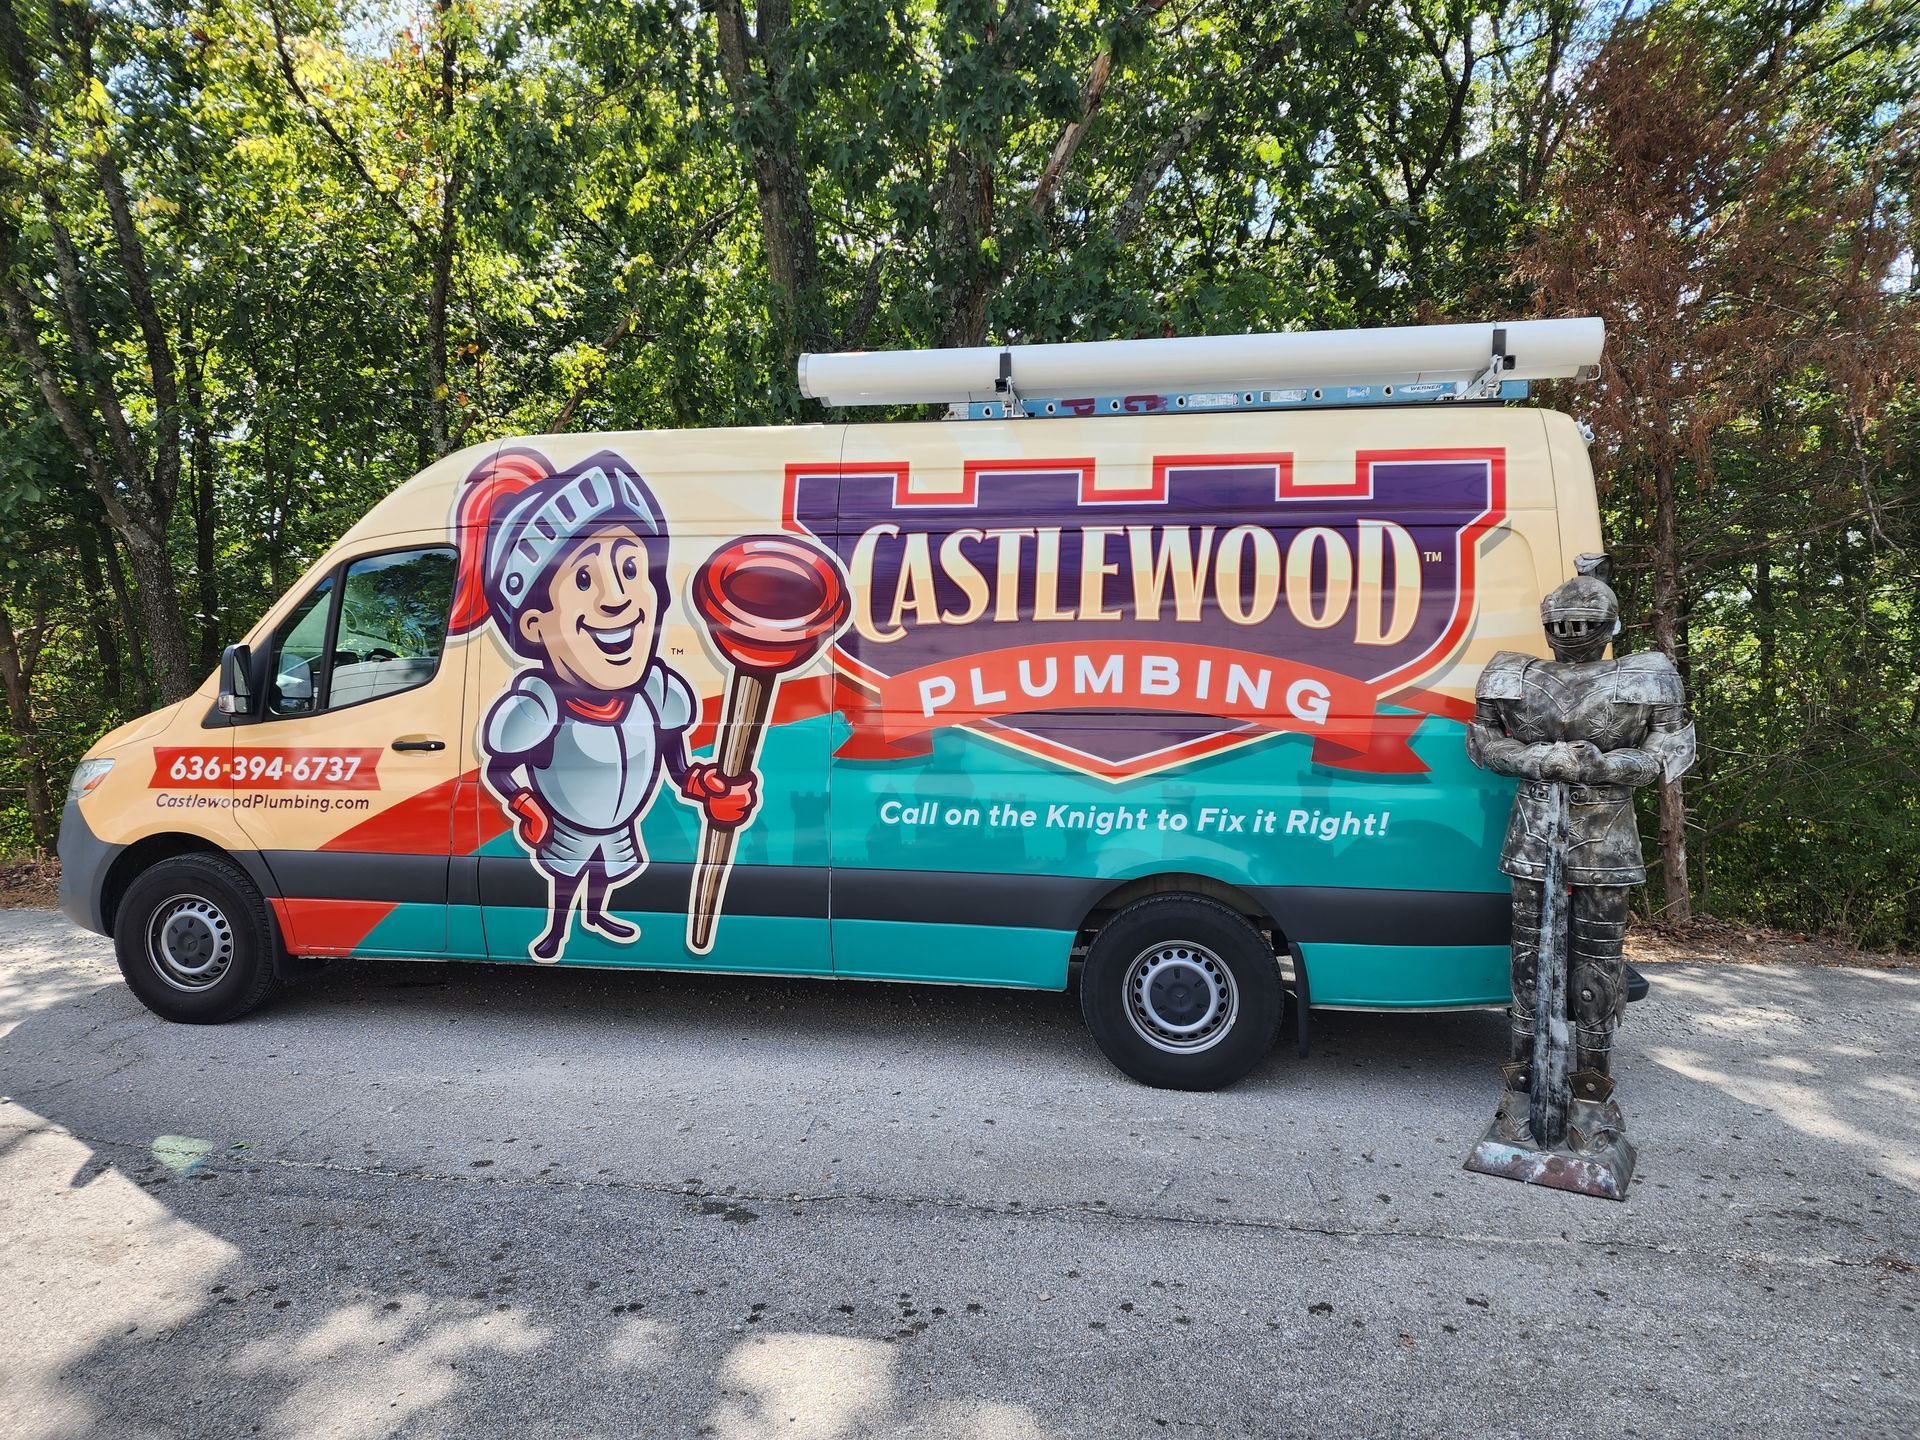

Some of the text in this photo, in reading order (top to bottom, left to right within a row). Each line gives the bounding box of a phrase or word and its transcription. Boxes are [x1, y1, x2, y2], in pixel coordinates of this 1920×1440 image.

[1410, 384, 1441, 392] WERNER
[850, 518, 1422, 646] CASTLEWOOD
[918, 655, 1333, 726] PLUMBING
[156, 793, 369, 812] CastlewoodPlumbing.com
[880, 801, 1390, 841] Call on the Knight to Fix it Right!
